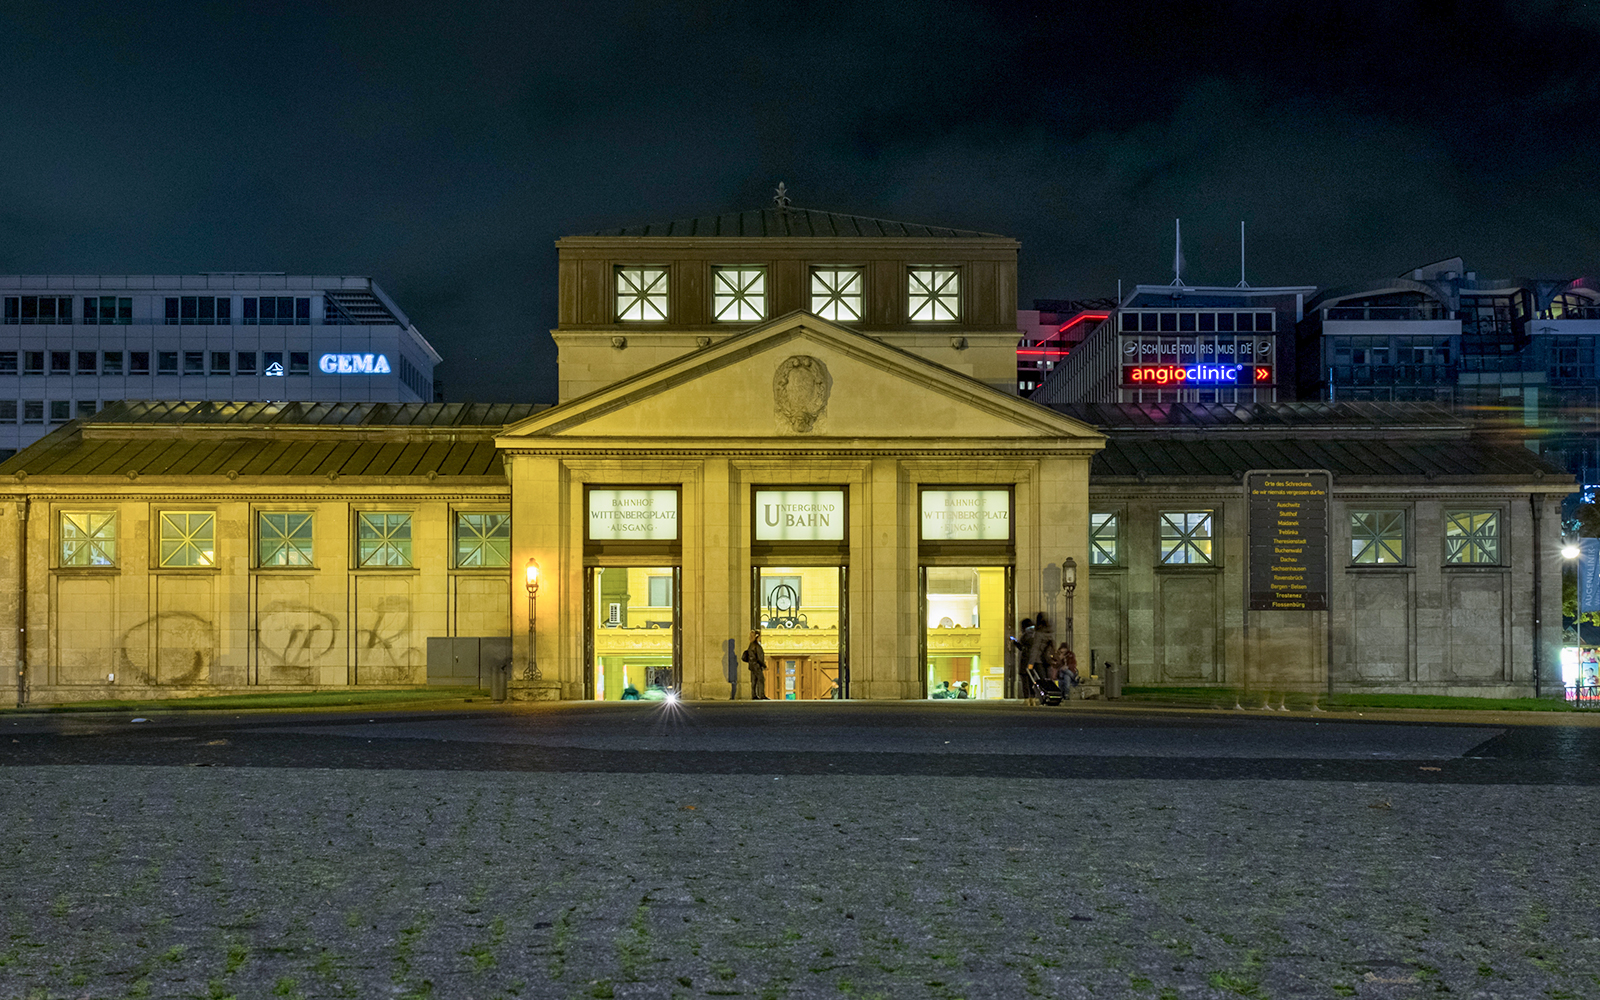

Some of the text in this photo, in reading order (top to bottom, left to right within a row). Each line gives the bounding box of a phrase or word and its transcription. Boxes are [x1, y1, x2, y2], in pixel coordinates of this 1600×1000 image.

[319, 353, 391, 374] GEMA
[612, 499, 654, 507] BAHNHOF
[944, 499, 987, 507] BAHNHOF
[591, 510, 676, 519] WITTENBERGPLATZ
[923, 510, 1008, 520] WTTENBERGPLATZ
[785, 513, 830, 527] BAHN
